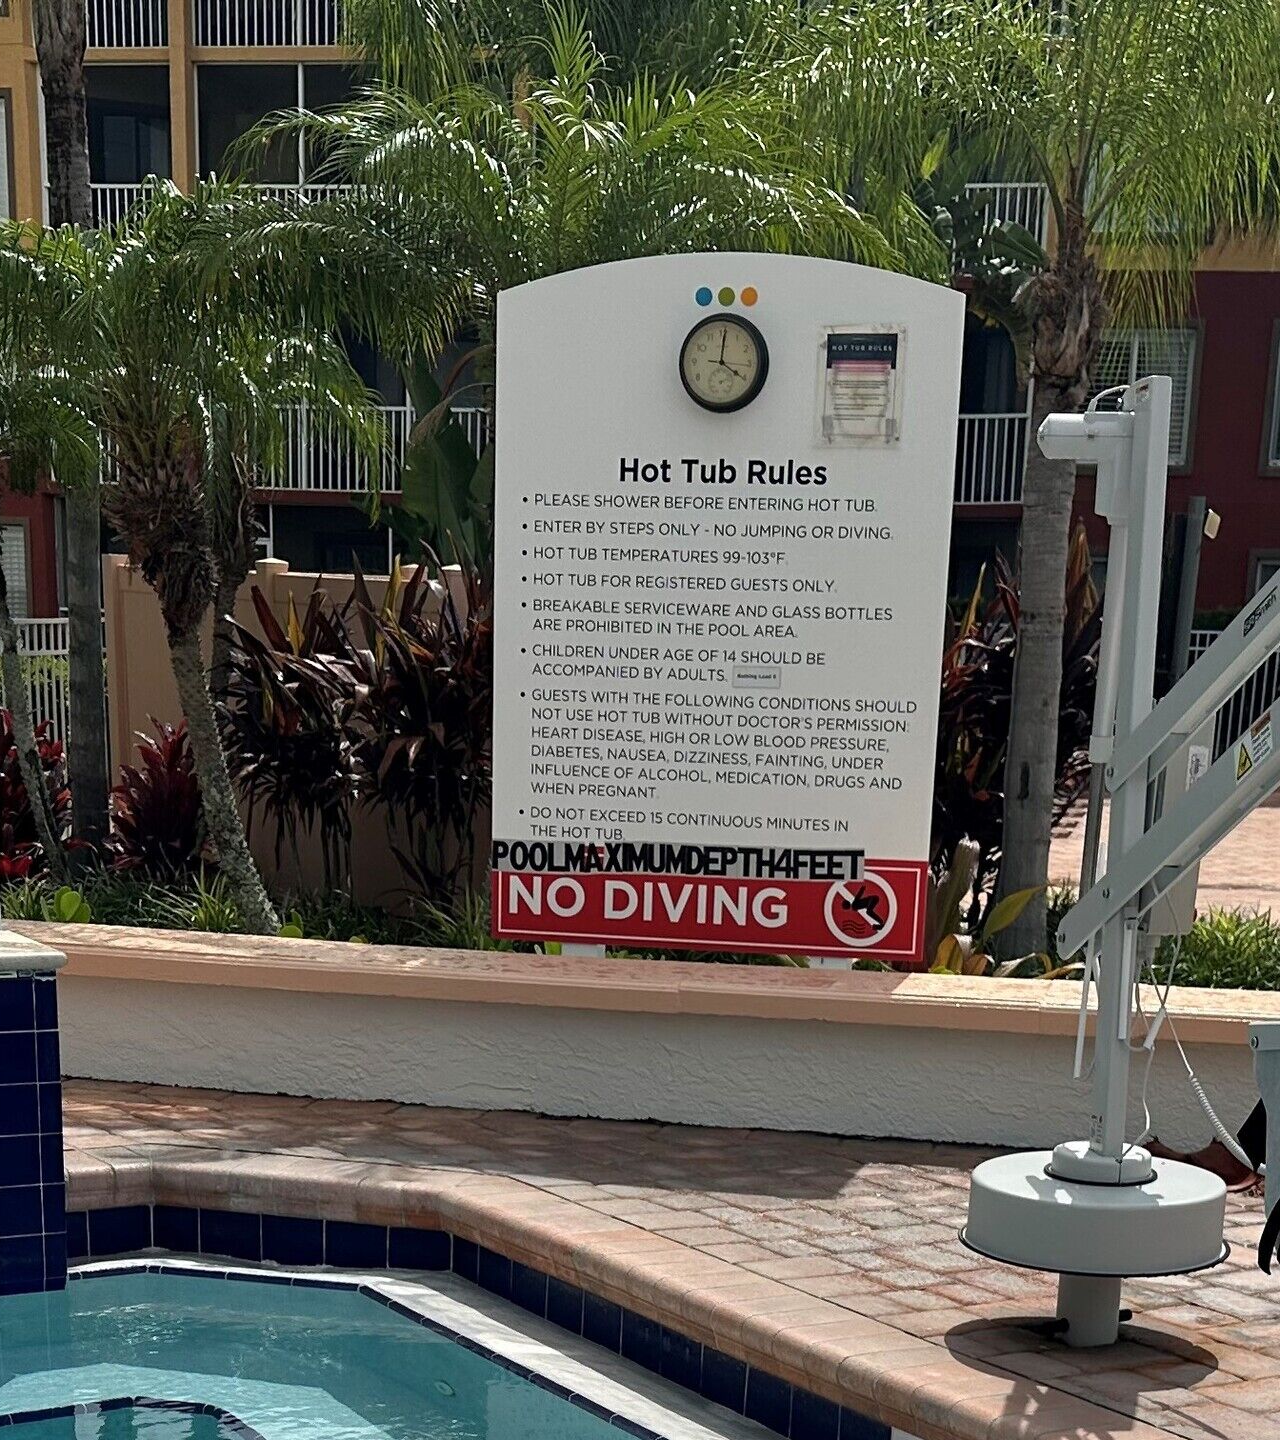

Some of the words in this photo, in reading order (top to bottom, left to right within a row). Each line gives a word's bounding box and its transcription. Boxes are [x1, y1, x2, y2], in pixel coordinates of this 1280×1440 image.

[619, 457, 671, 483] Hot
[680, 458, 736, 484] Tub
[747, 459, 827, 485] Rules
[534, 493, 590, 507] PLEASE
[593, 494, 660, 508] SHOWER
[664, 495, 724, 510] BEFORE
[728, 497, 803, 511] ENTERING
[807, 498, 840, 512] HOT
[534, 519, 581, 533] ENTER
[586, 521, 605, 534] BY
[609, 521, 655, 535] STEPS
[658, 522, 700, 536] ONLY
[713, 523, 737, 537] NO
[740, 524, 807, 538] JUMPING
[811, 525, 834, 539] OR
[533, 546, 564, 559] HOT
[568, 547, 597, 560] TUB
[601, 548, 719, 563] TEMPERATURES
[533, 573, 564, 586] HOT
[567, 573, 597, 587] TUB
[600, 574, 631, 587] FOR
[635, 575, 726, 590] REGISTERED
[730, 577, 788, 592] GUESTS
[532, 598, 620, 614] BREAKABLE
[624, 601, 731, 616] SERVICEWARE
[734, 604, 768, 618] AND
[771, 605, 821, 619] GLASS
[825, 606, 893, 620] BOTTLES
[532, 618, 562, 631] ARE
[566, 619, 653, 634] PROHIBITED
[656, 622, 671, 634] IN
[675, 622, 704, 636] THE
[708, 623, 750, 637] POOL
[532, 644, 604, 658] CHILDREN
[608, 646, 659, 660] UNDER
[662, 648, 694, 661] AGE
[697, 649, 719, 662] OF
[722, 649, 736, 662] 14
[740, 650, 802, 664] SHOULD
[806, 652, 826, 665] BE
[531, 663, 639, 678] ACCOMPANIED
[643, 666, 663, 679] BY
[531, 688, 587, 702] GUESTS
[590, 691, 628, 704] WITH
[632, 691, 660, 705] THE
[664, 693, 754, 708] FOLLOWING
[758, 696, 851, 711] CONDITIONS
[854, 699, 917, 713] SHOULD
[531, 707, 562, 720] NOT
[565, 708, 593, 722] USE
[597, 710, 628, 723] HOT
[631, 710, 660, 724] TUB
[664, 712, 734, 726] WITHOUT
[737, 714, 812, 729] DOCTOR'S
[531, 726, 579, 739] HEART
[649, 731, 685, 744] HIGH
[688, 732, 710, 745] OR
[714, 733, 750, 746] LOW
[753, 734, 806, 748] BLOOD
[831, 756, 884, 770] UNDER
[530, 763, 610, 778] INFLUENCE
[613, 766, 634, 779] OF
[814, 774, 866, 788] DRUGS
[868, 776, 902, 790] AND
[530, 781, 574, 795] WHEN
[530, 806, 552, 819] DO
[555, 807, 585, 820] NOT
[589, 809, 646, 823] EXCEED
[650, 811, 663, 824] 15
[666, 812, 763, 828] CONTINUOUS
[766, 817, 830, 831] MINUTES
[834, 819, 848, 832] IN
[529, 824, 557, 837] THE
[561, 826, 591, 839] HOT
[509, 875, 585, 917] NO
[604, 880, 788, 928] DIVING
